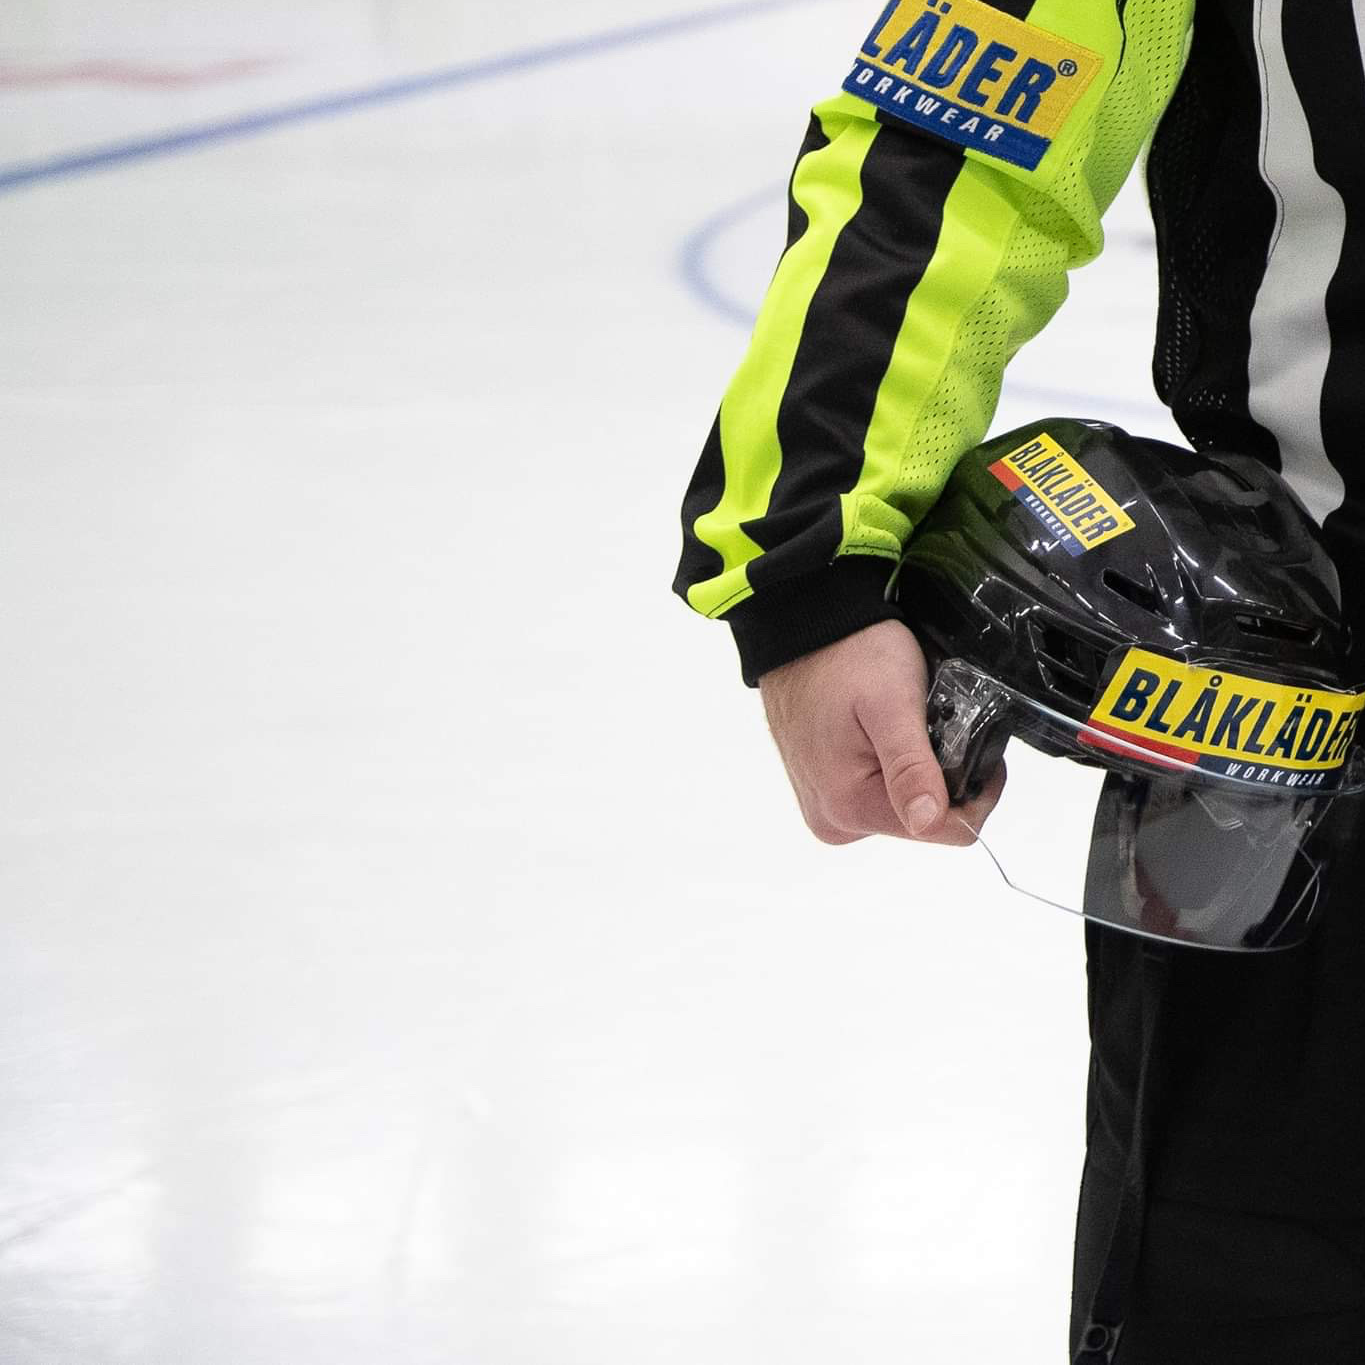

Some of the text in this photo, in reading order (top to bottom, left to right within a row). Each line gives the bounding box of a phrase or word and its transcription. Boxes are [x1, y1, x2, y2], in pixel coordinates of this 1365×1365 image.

[850, 63, 1005, 142] ORKWEAR
[1008, 441, 1119, 542] BLÅKLÄDER
[1025, 493, 1073, 541] WORKWEAR
[1224, 762, 1326, 787] WORKWEAR
